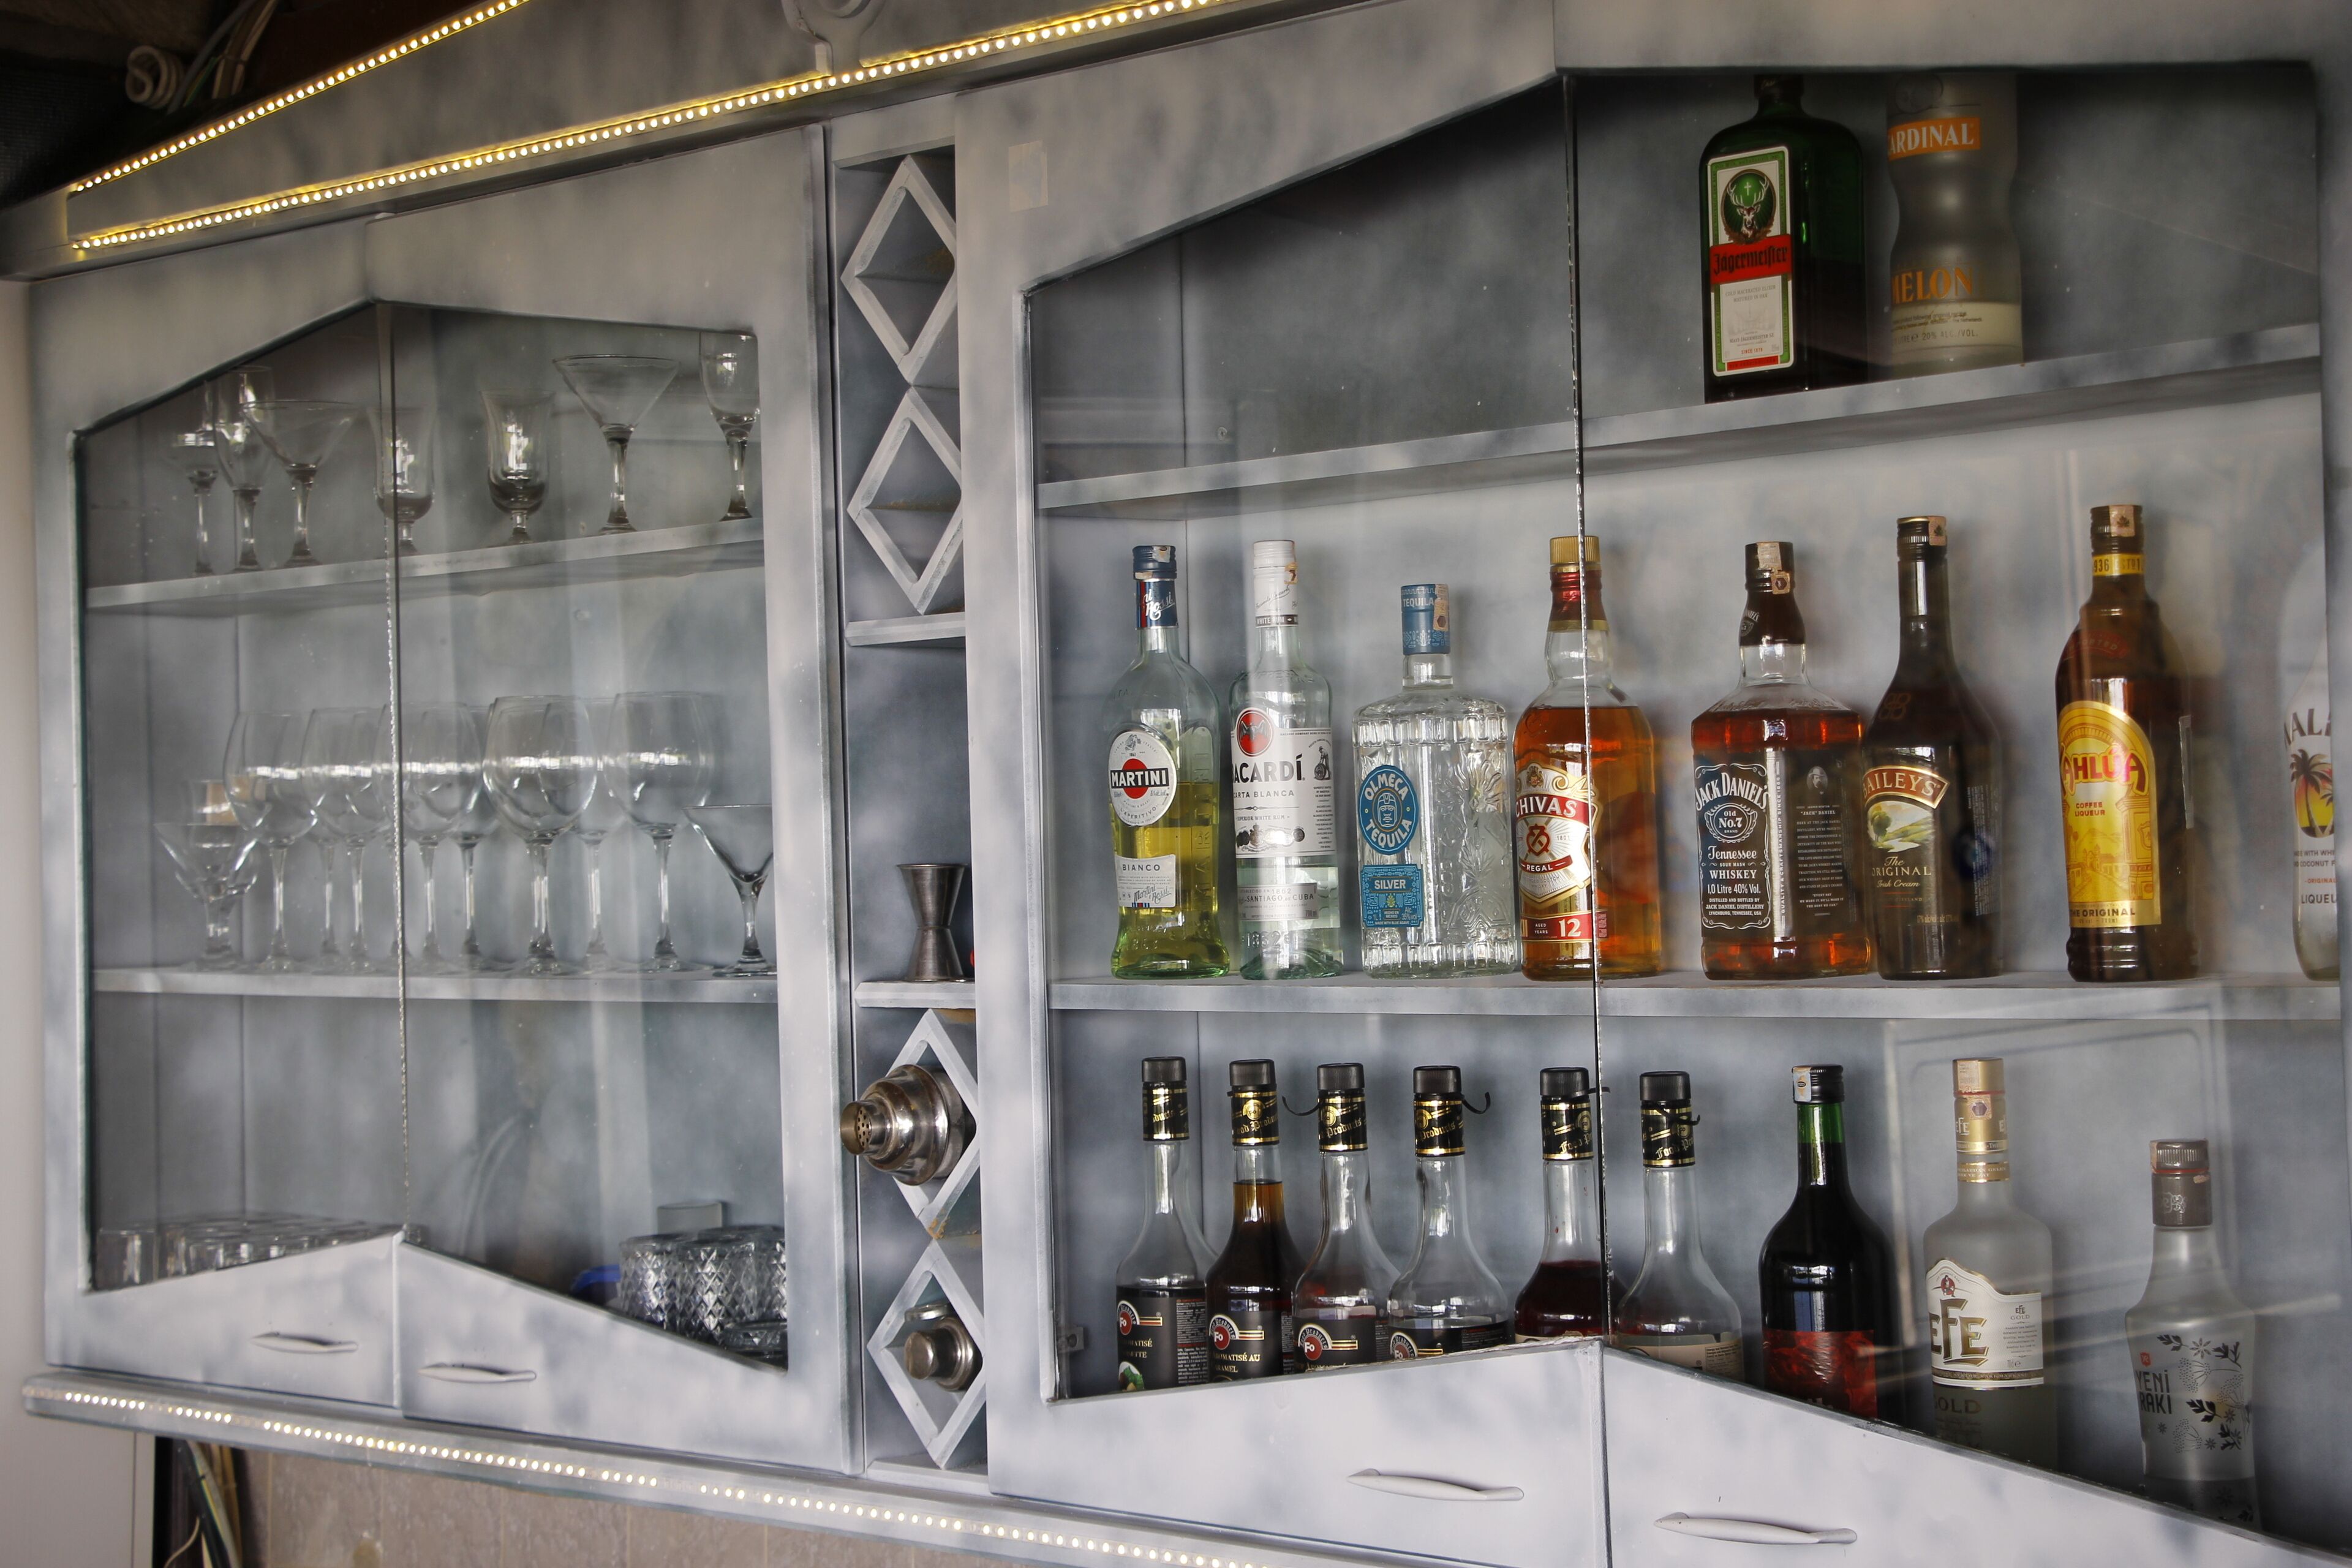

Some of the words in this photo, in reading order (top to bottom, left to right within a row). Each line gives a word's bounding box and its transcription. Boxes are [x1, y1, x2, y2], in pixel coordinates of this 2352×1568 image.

[1888, 123, 1974, 155] ARDINAL
[2094, 559, 2109, 572] 936
[1403, 597, 1434, 608] TEQUILA
[1233, 753, 1303, 784] ACARDÍ
[1111, 769, 1167, 787] MARTINI
[1364, 773, 1409, 801] OLMECA
[1695, 778, 1722, 811] JACK
[1721, 772, 1770, 809] DANIEL'S
[1120, 806, 1157, 819] L'APERITIVO
[1516, 796, 1578, 818] CHIVAS
[1366, 819, 1412, 848] TEQUILA
[1708, 845, 1757, 859] Tennessee
[1526, 864, 1553, 872] REGAL
[1884, 856, 1905, 867] The
[1709, 870, 1757, 880] WHISKEY
[1872, 866, 1931, 876] ORIGINAL
[1374, 880, 1406, 889] SILVER
[1717, 884, 1732, 894] Litre
[1733, 884, 1747, 894] 40%
[1749, 884, 1761, 894] Vol.
[1893, 879, 1920, 888] Cream
[1134, 884, 1156, 903] Martini
[2301, 894, 2336, 904] LIQUEU
[2082, 908, 2136, 918] ORIGINAL
[1558, 918, 1581, 937] 12
[2015, 1305, 2026, 1314] EFE
[1928, 1298, 1989, 1366] EFE
[2139, 1391, 2173, 1414] RAKI
